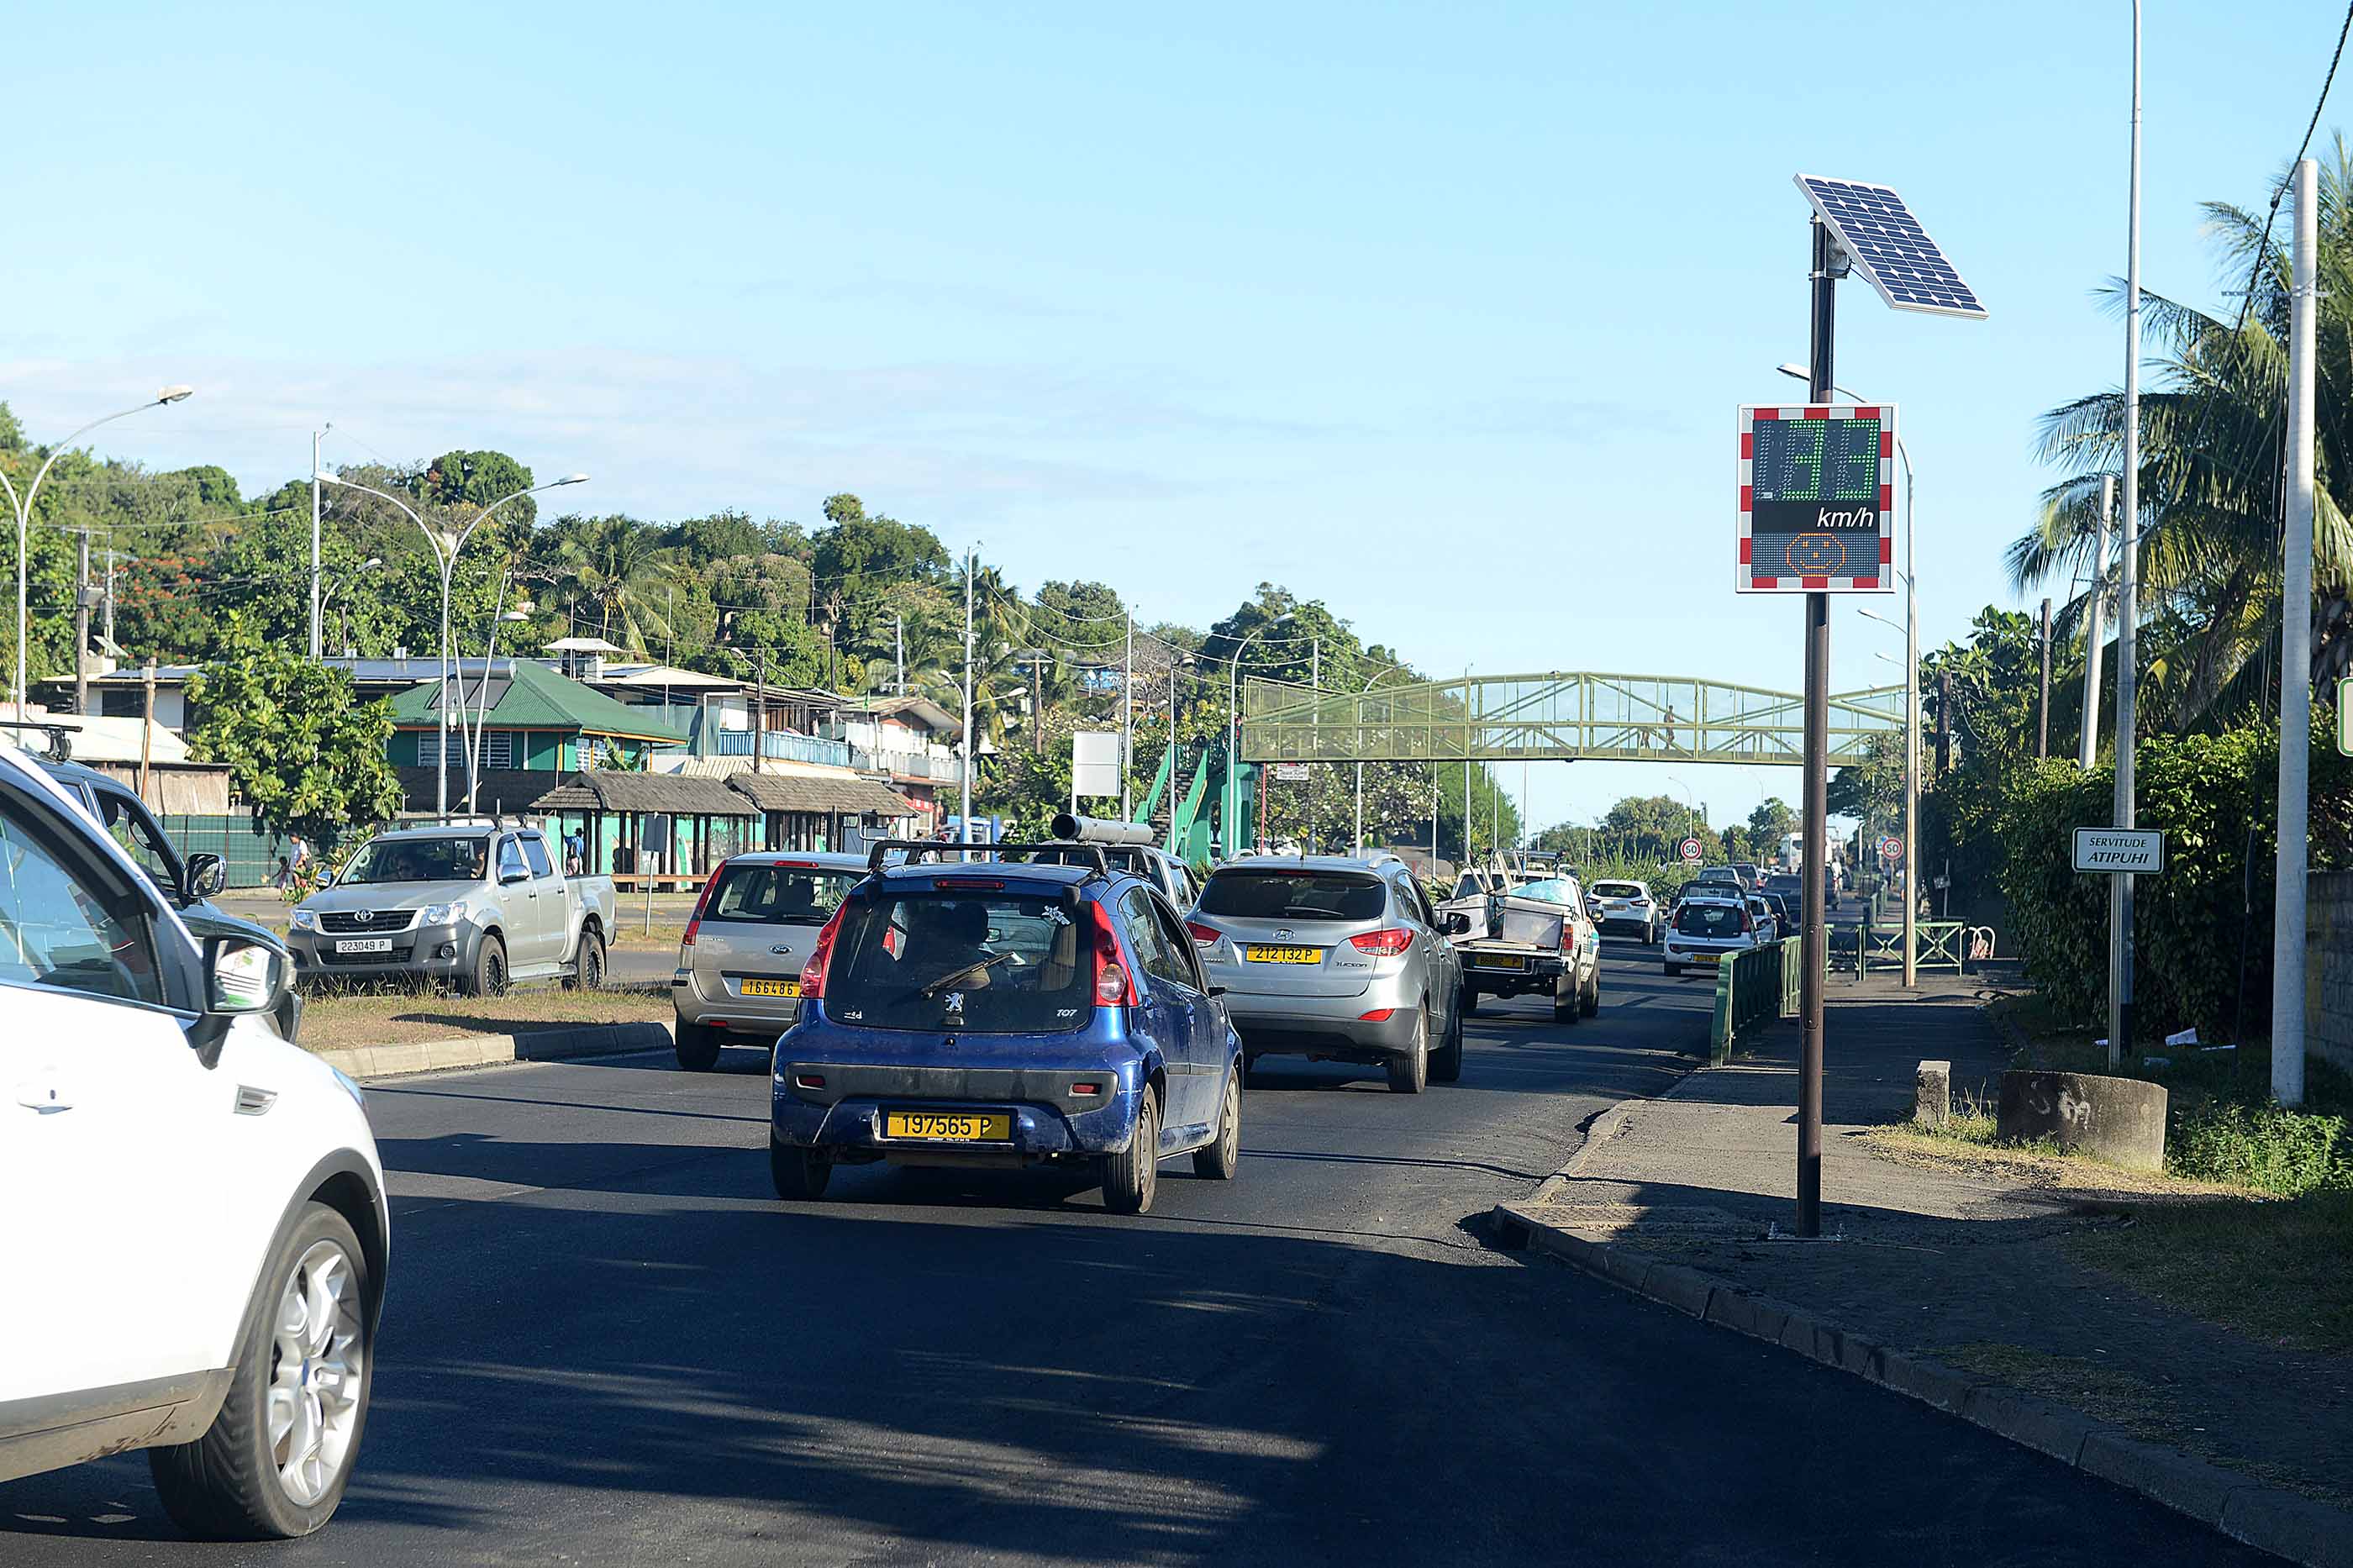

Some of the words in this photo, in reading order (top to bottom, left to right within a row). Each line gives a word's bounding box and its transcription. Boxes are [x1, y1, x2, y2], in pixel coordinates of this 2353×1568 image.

[1816, 507, 1875, 528] km/h
[2089, 837, 2147, 848] SERVITUDE
[1685, 845, 1698, 854] 50
[1886, 844, 1898, 854] 50
[2087, 851, 2150, 864] ATIPUHI
[341, 940, 376, 951] 223049
[379, 940, 385, 950] P
[749, 981, 793, 995] 166486
[1056, 1009, 1078, 1018] 107
[902, 1114, 971, 1135] 197565
[980, 1116, 992, 1135] P
